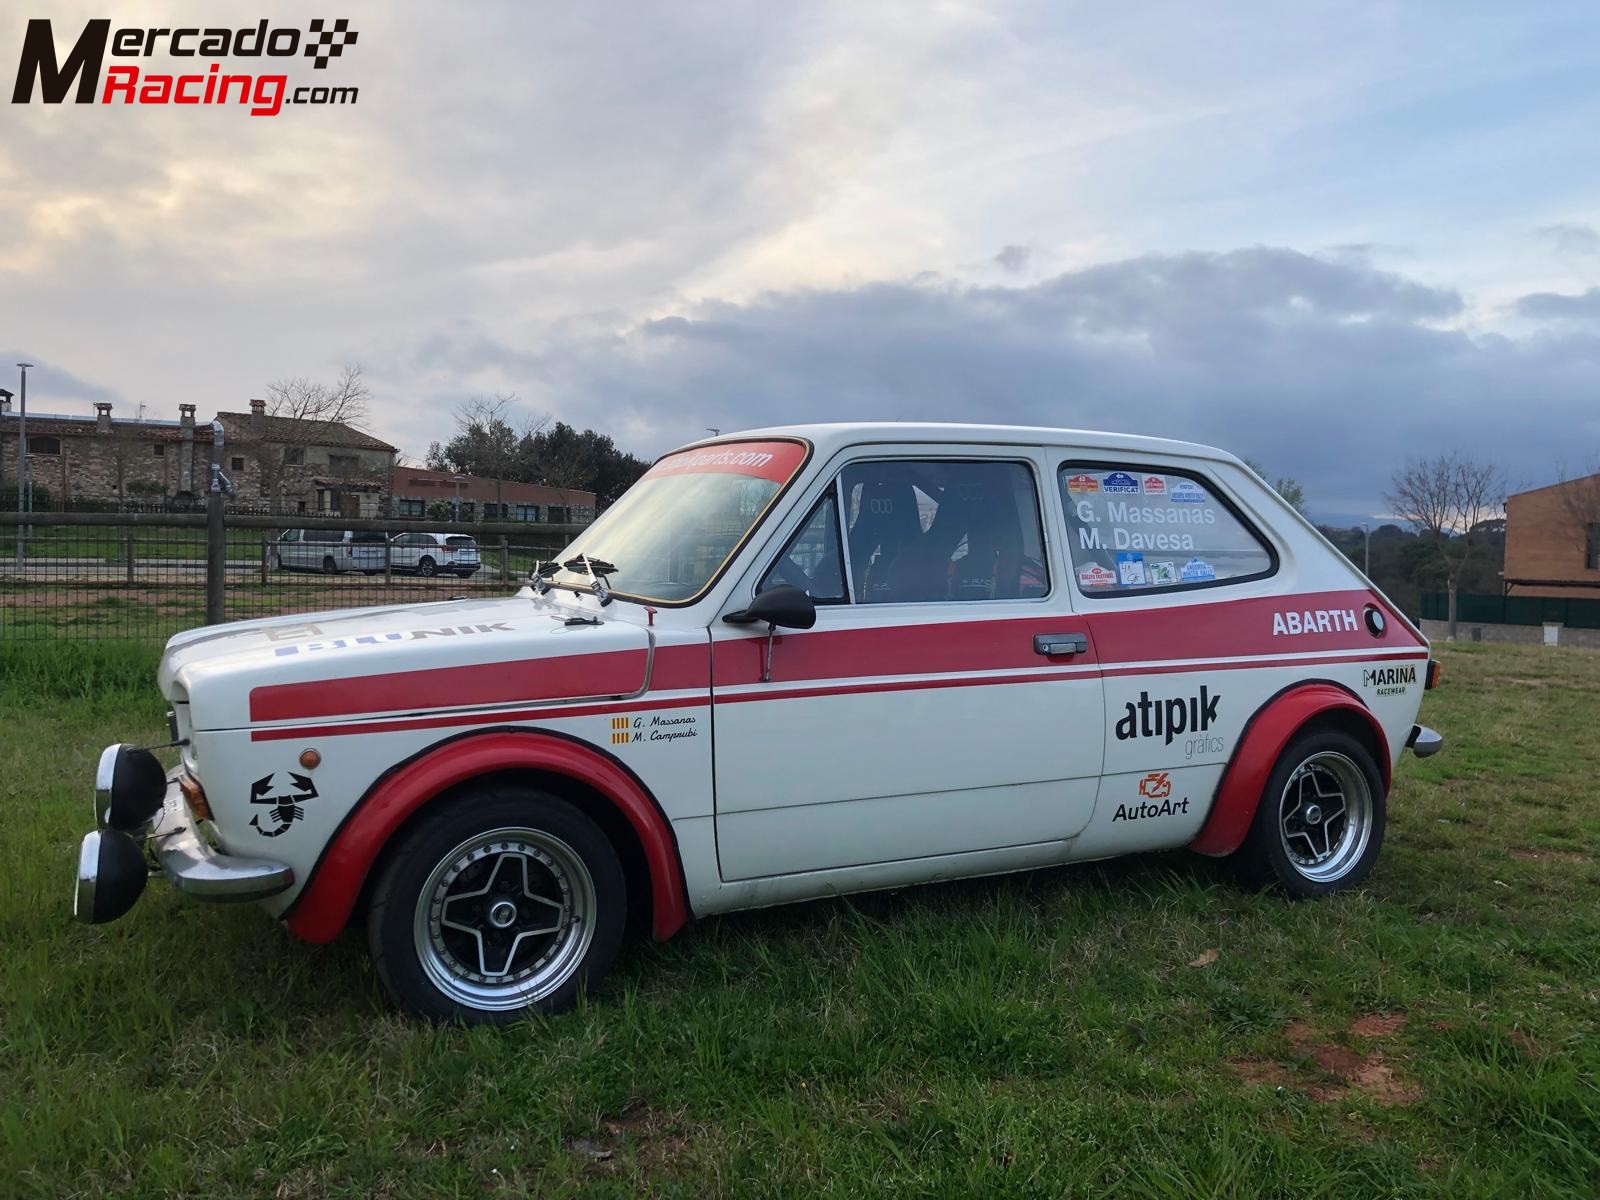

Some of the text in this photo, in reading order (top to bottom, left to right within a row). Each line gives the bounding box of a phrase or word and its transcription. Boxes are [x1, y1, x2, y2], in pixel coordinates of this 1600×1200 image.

[1077, 501, 1216, 524] G. Massanas
[1079, 528, 1194, 550] M. Davesa
[1273, 609, 1358, 636] ABARTH
[1363, 666, 1416, 687] MARINA
[1377, 687, 1406, 696] RACEWEAR
[633, 716, 696, 729] G. Massanas
[1115, 685, 1221, 746] atipik
[632, 732, 647, 743] M.
[1112, 797, 1189, 822] AutoArt
